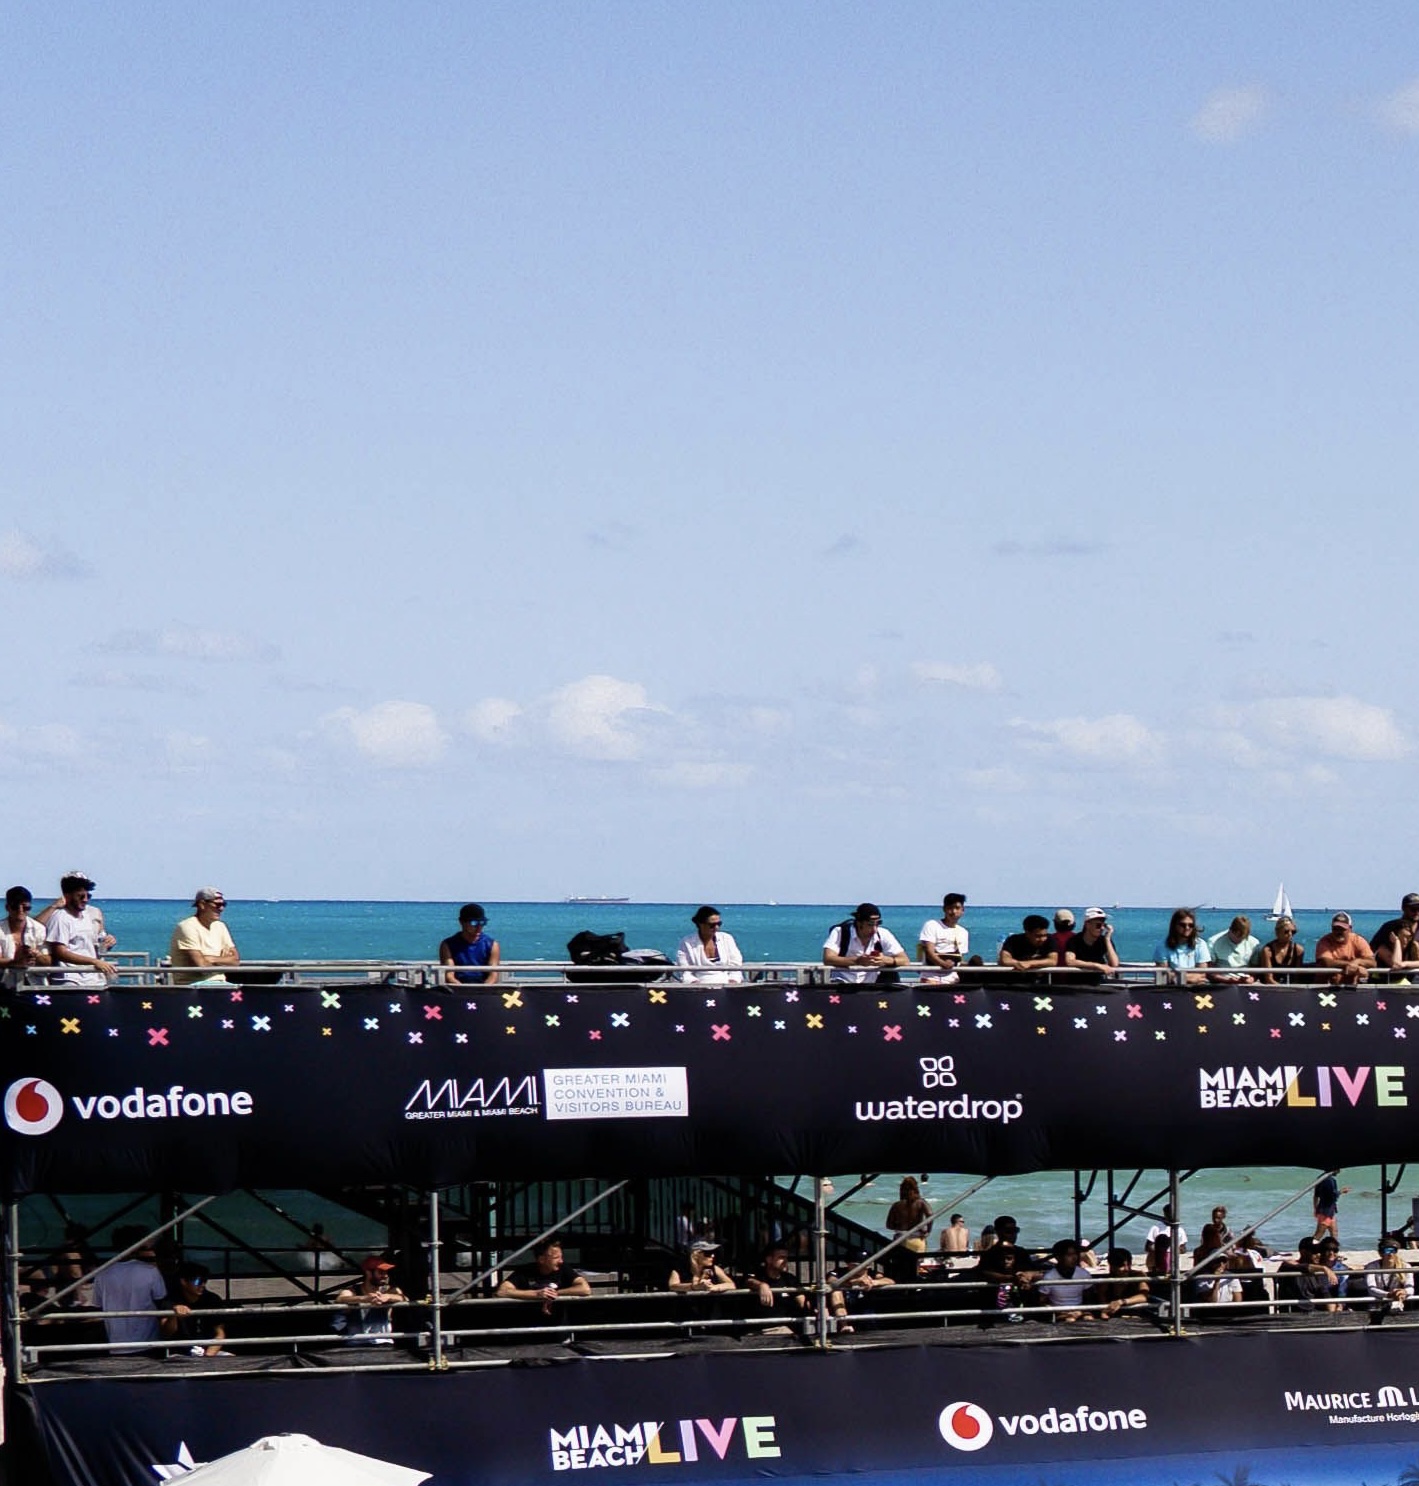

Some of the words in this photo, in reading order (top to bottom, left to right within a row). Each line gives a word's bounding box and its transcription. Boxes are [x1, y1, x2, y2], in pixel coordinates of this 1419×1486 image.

[552, 1074, 621, 1086] GREATER
[625, 1073, 667, 1084] MIAMI
[1200, 1066, 1296, 1090] MIAMI
[1285, 1066, 1408, 1108] LIVE
[72, 1085, 253, 1121] vodafone
[405, 1075, 538, 1110] MIAMI
[553, 1087, 651, 1100] CONVENTION
[655, 1087, 665, 1098] &
[1200, 1089, 1283, 1109] BEACH
[404, 1110, 446, 1121] GREATER
[508, 1106, 538, 1116] BEACH
[554, 1100, 620, 1114] VISITORS
[624, 1100, 683, 1112] BUREAU
[855, 1094, 1022, 1124] waterdrop
[1284, 1389, 1372, 1411] MAURICE
[998, 1405, 1148, 1437] vodafone
[1329, 1411, 1384, 1424] Manufacture
[551, 1422, 659, 1453] MIAMI
[646, 1415, 782, 1464] LIVE
[552, 1445, 645, 1471] BEACH
